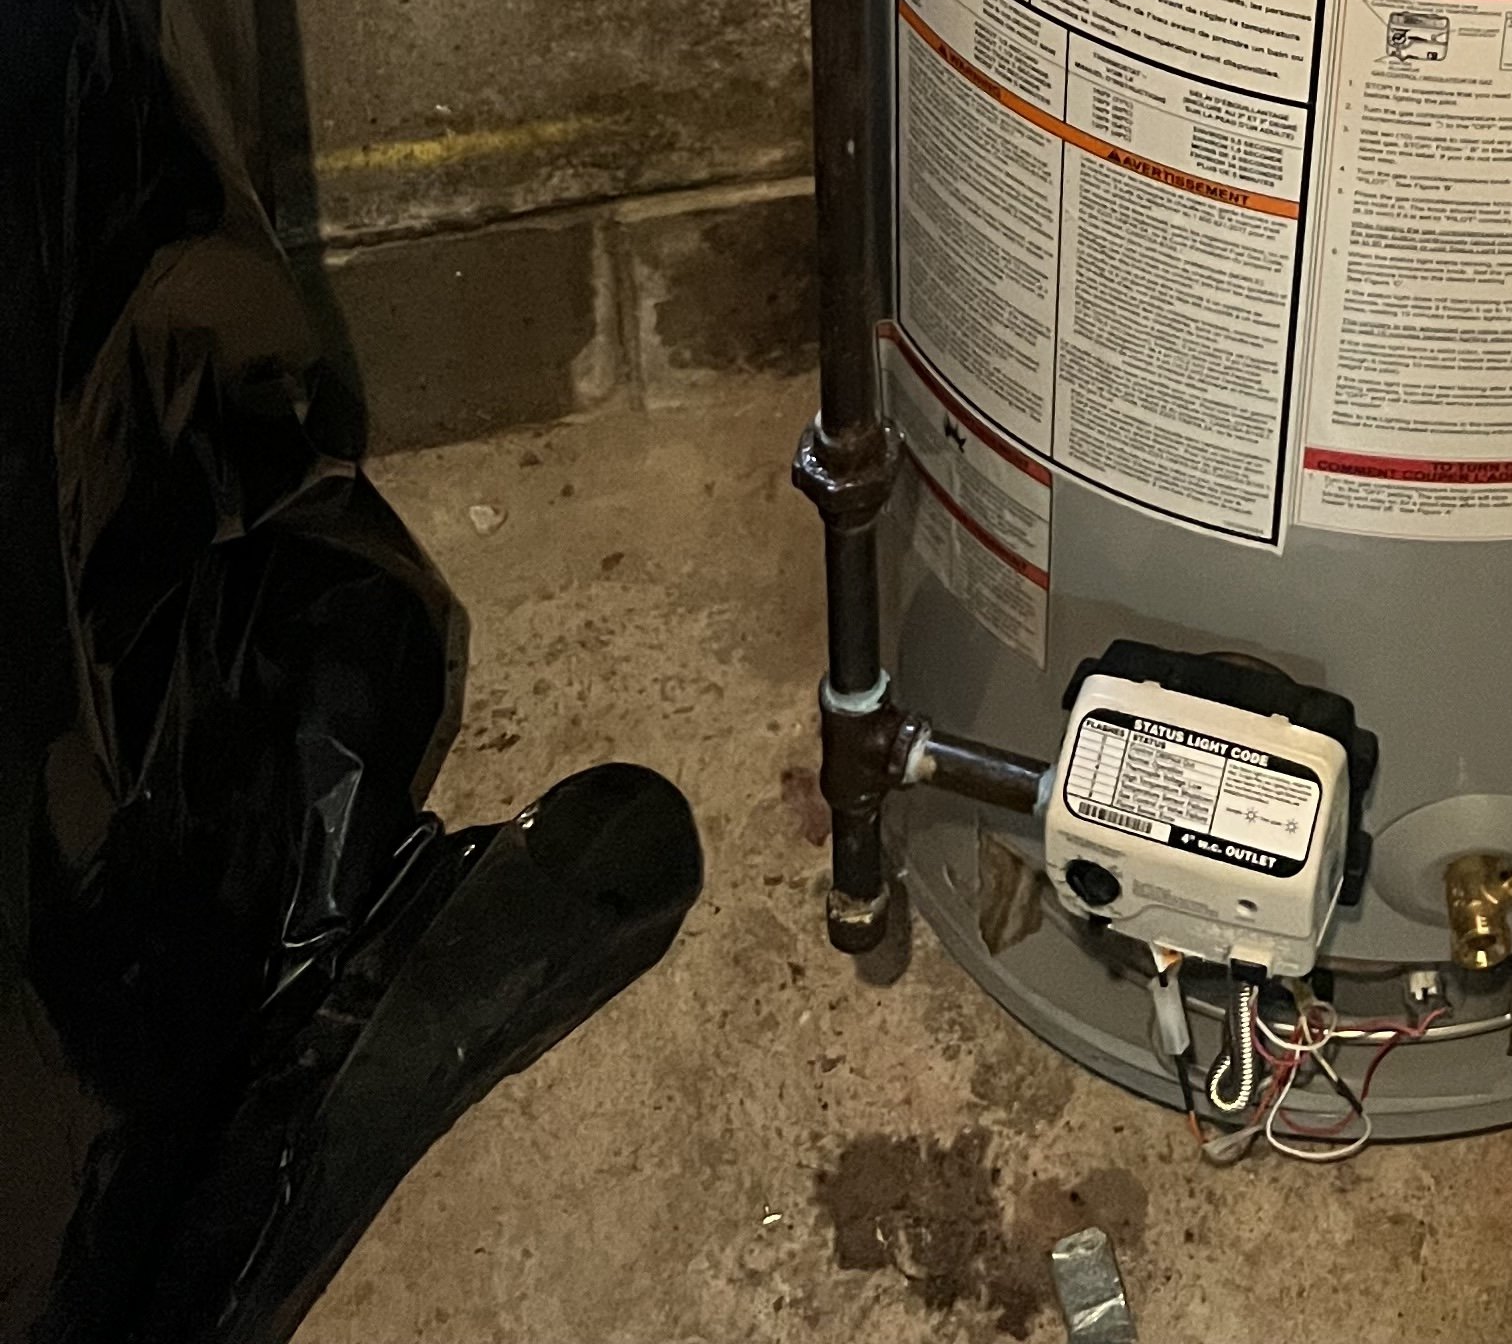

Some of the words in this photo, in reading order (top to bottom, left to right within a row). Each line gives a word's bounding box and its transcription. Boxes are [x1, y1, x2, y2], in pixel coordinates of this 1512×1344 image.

[1122, 154, 1251, 206] AVERTISSEMENT
[1133, 734, 1166, 749] STATUS
[1133, 719, 1185, 743] STATUS
[1187, 734, 1229, 755] LIGHT
[1231, 747, 1270, 767] CODE
[1225, 846, 1277, 869] OUTLET
